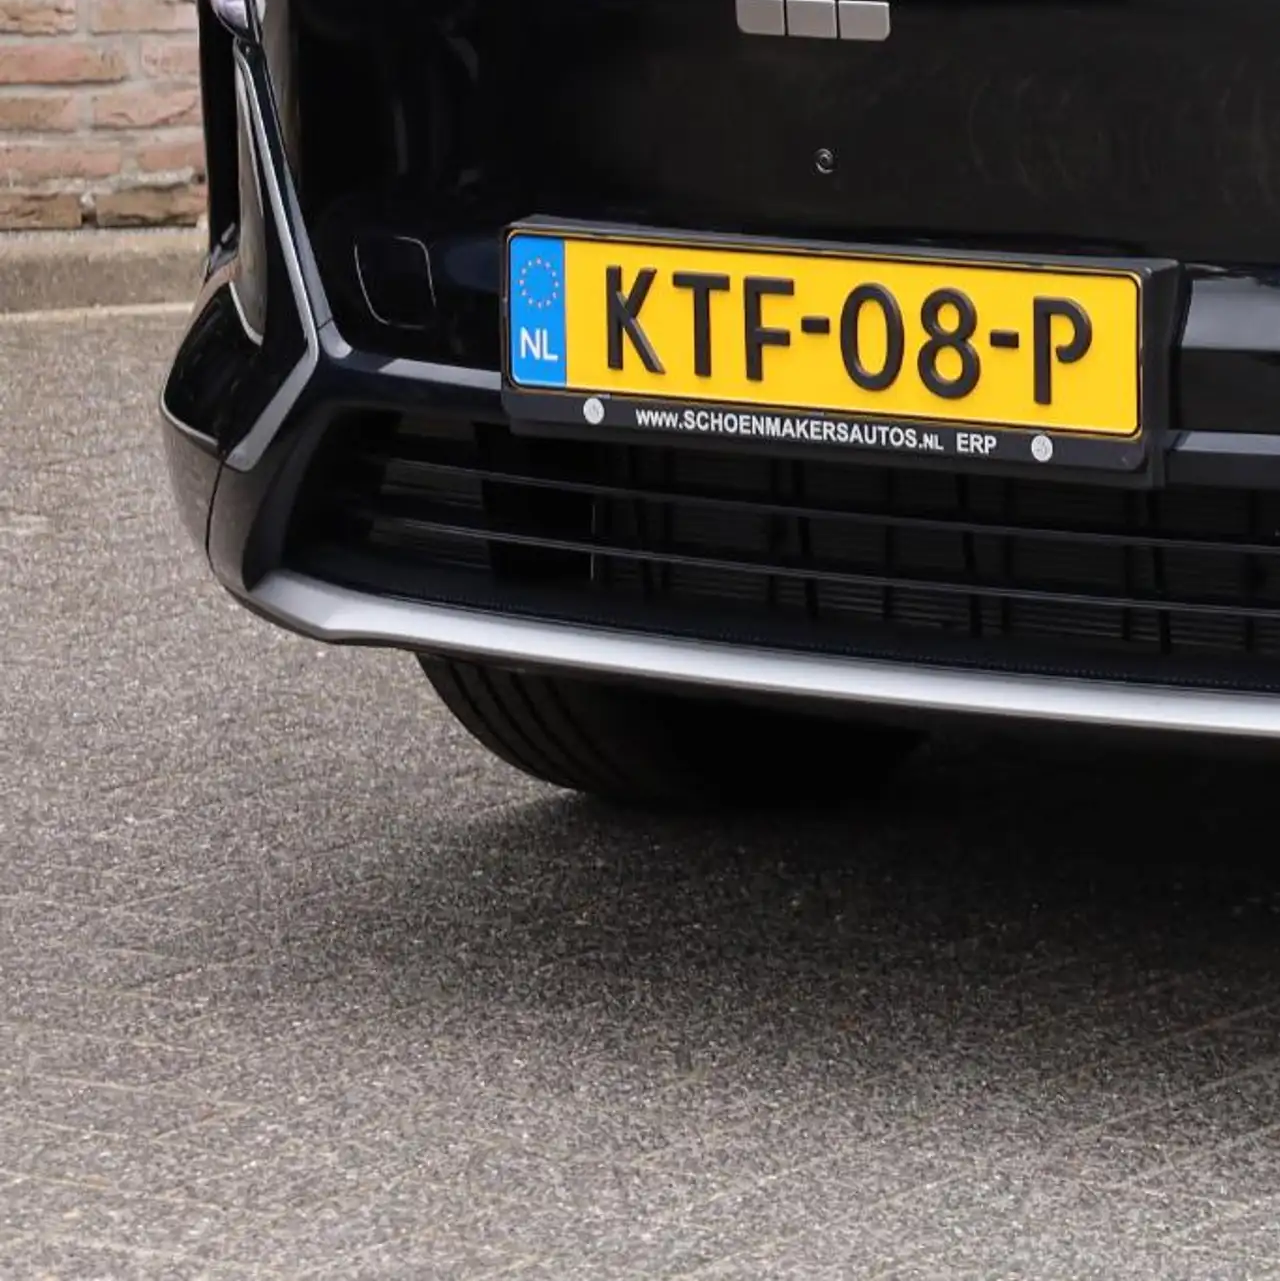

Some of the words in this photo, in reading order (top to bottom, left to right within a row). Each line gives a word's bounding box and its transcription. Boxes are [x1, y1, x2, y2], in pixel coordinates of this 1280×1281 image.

[519, 326, 559, 361] NL
[605, 265, 1093, 405] KTF-08-P
[956, 431, 998, 454] ERP
